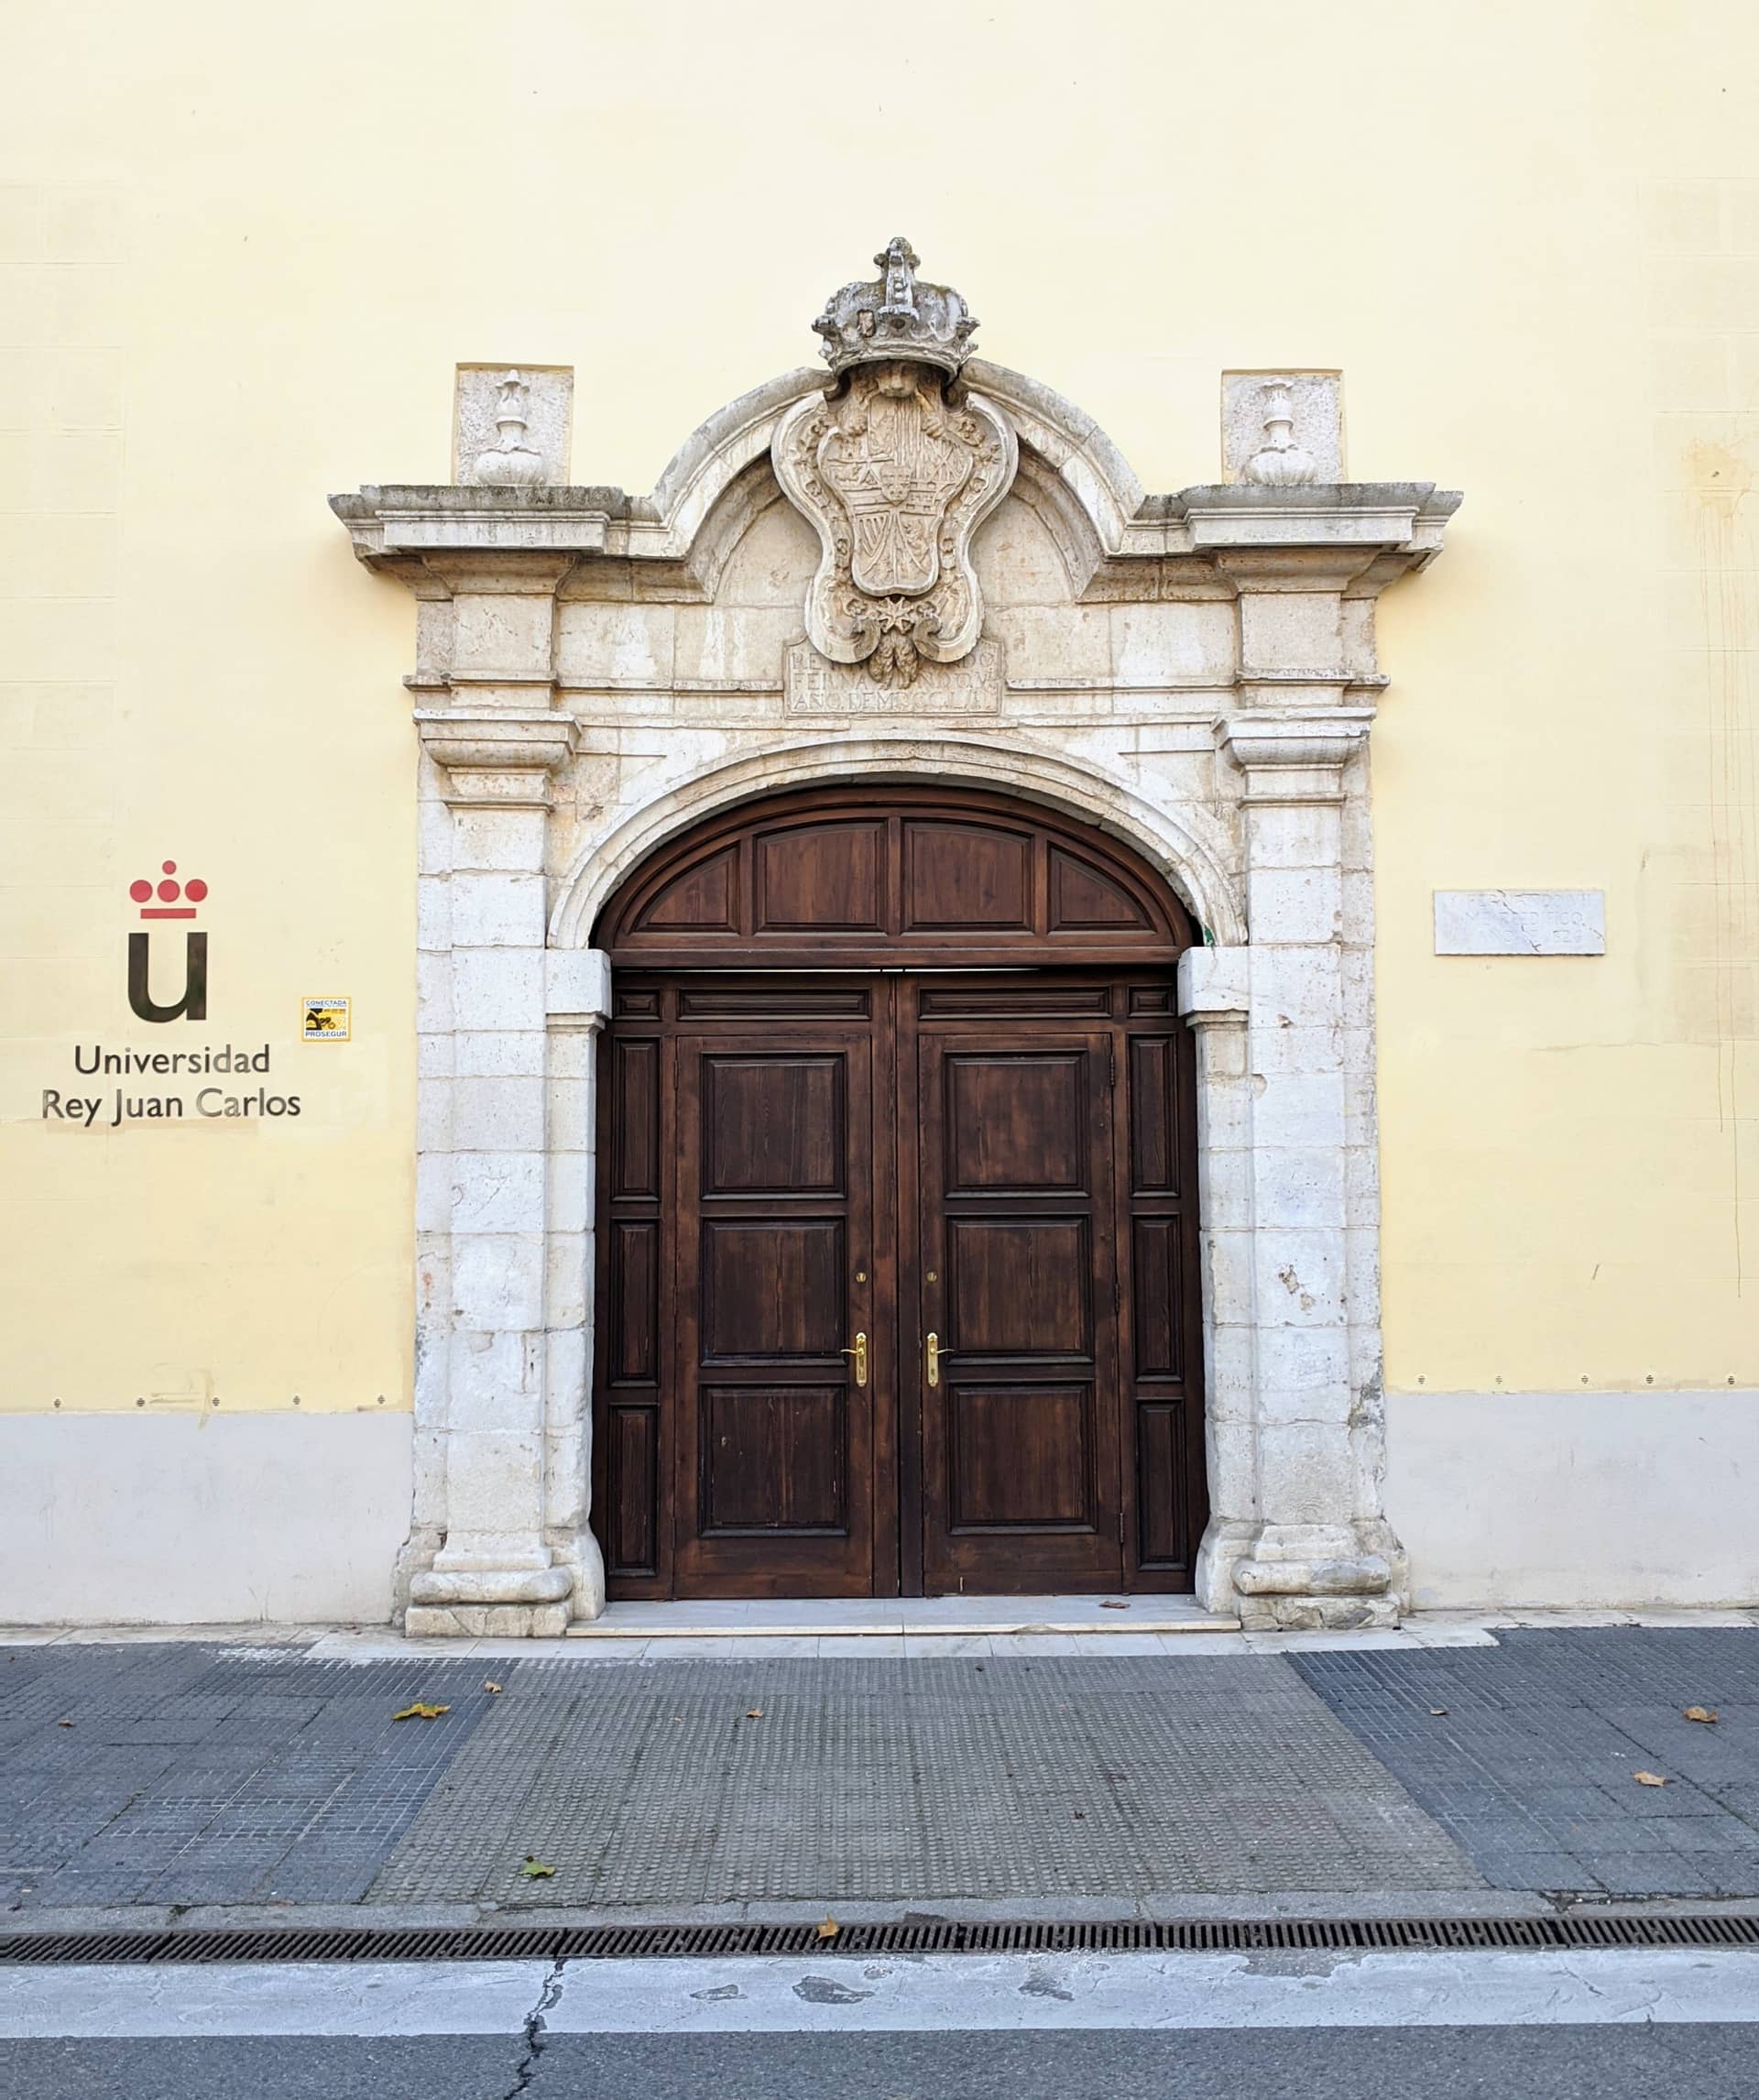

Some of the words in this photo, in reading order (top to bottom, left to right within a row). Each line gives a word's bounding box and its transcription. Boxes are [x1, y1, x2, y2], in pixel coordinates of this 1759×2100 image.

[74, 1044, 270, 1075] Universidad
[42, 1088, 103, 1127] Rey
[111, 1088, 183, 1127] Juan
[195, 1088, 301, 1118] Carlos
